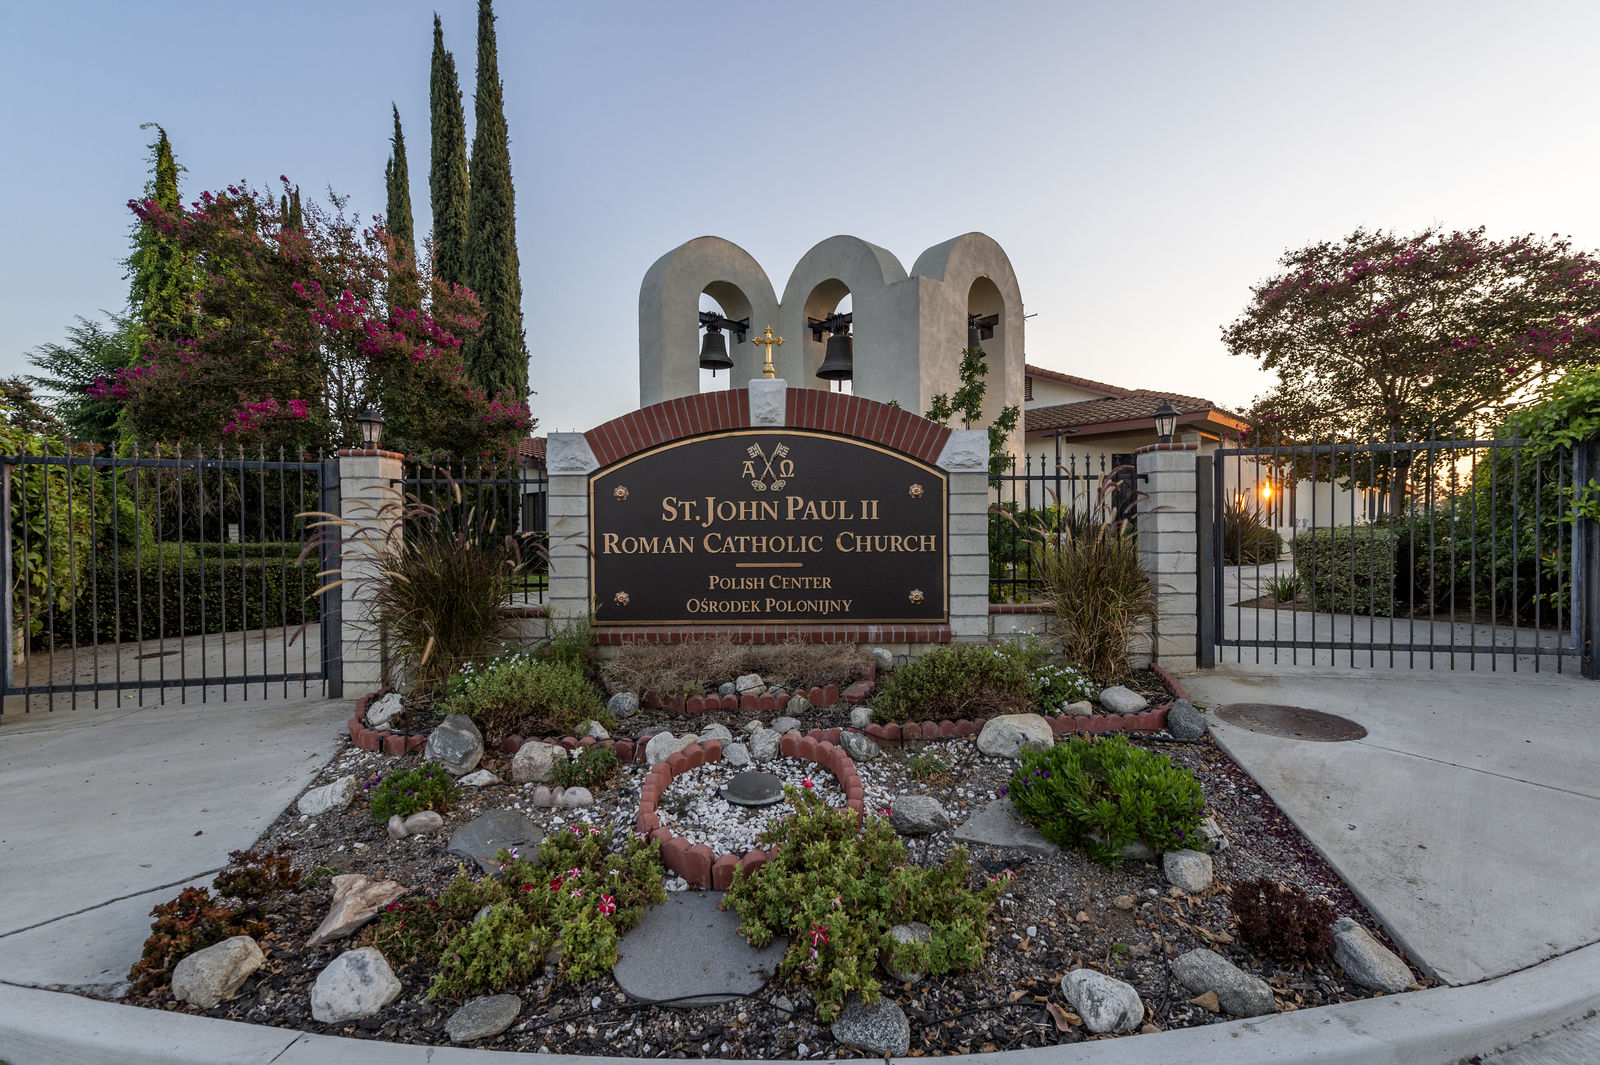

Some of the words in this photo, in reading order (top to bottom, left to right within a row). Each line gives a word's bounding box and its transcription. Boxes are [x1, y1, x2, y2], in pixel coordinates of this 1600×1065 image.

[702, 496, 779, 528] JOHN
[785, 495, 854, 521] PAUL
[860, 500, 879, 520] II
[602, 532, 695, 554] ROMAN
[703, 532, 824, 553] CATHOLIC
[835, 531, 937, 553] CHURCH
[708, 575, 765, 590] POLISH
[769, 574, 832, 589] CENTER
[686, 597, 761, 613] OŚRODEK
[765, 598, 853, 615] POLONIJNY
